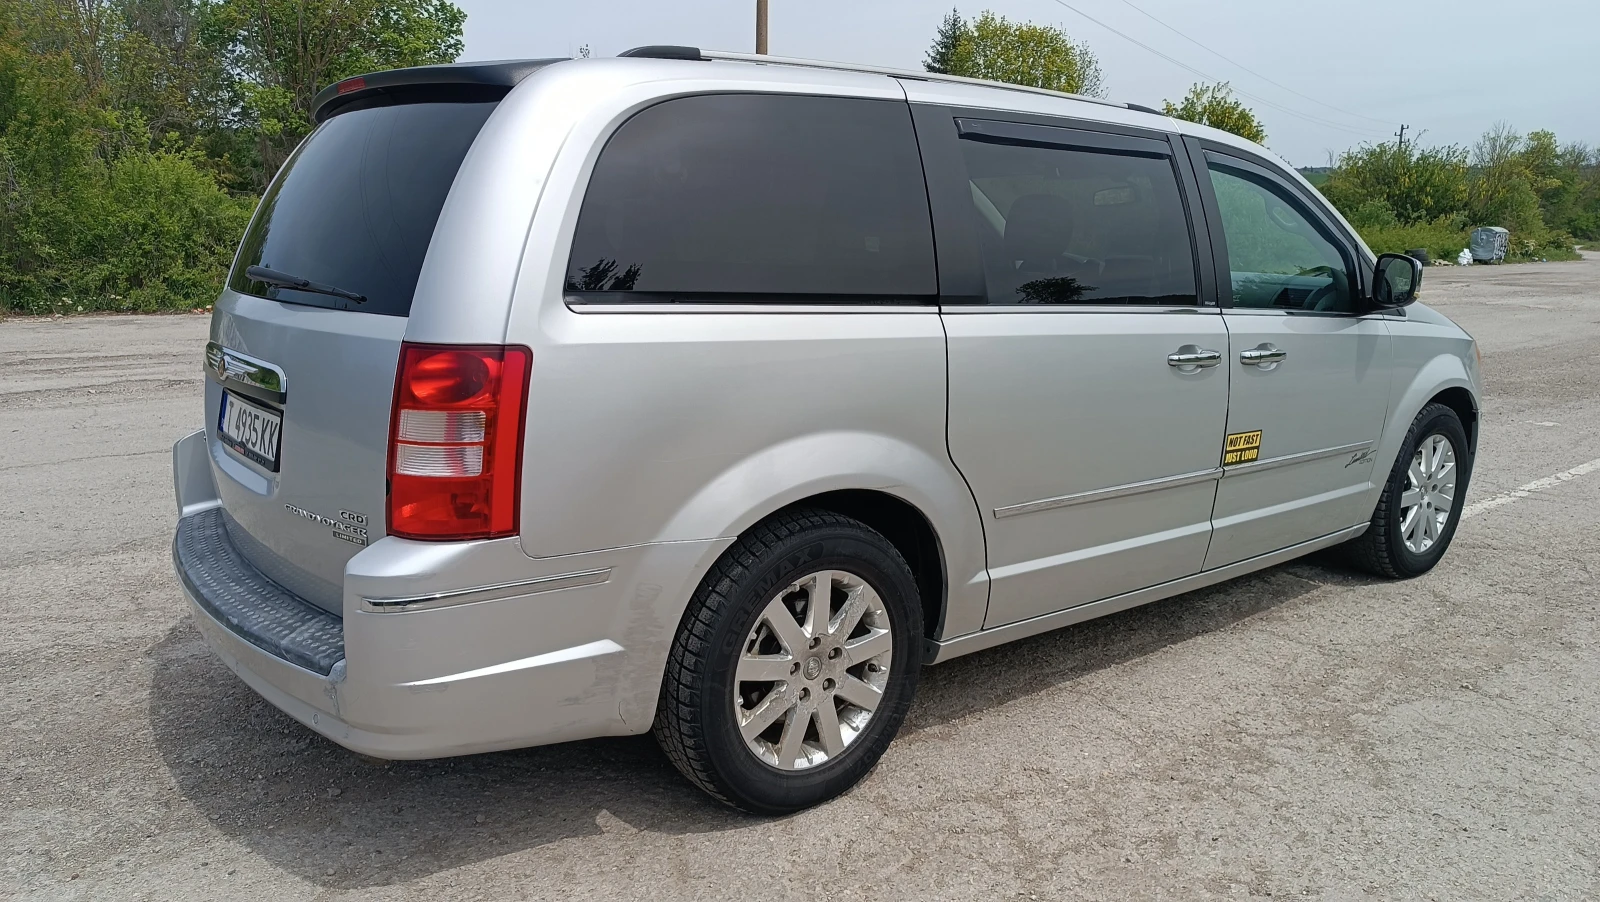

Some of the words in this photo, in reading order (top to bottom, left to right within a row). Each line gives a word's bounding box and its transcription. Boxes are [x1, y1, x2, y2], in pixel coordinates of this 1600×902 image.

[228, 400, 235, 434] T
[235, 407, 260, 449] 4935
[260, 417, 279, 459] KK
[1228, 435, 1243, 448] NOT
[1243, 433, 1260, 446] FAST
[1224, 451, 1241, 464] JUST
[1241, 448, 1258, 460] LOUD
[340, 510, 365, 524] CRD
[335, 532, 362, 544] LIMITED
